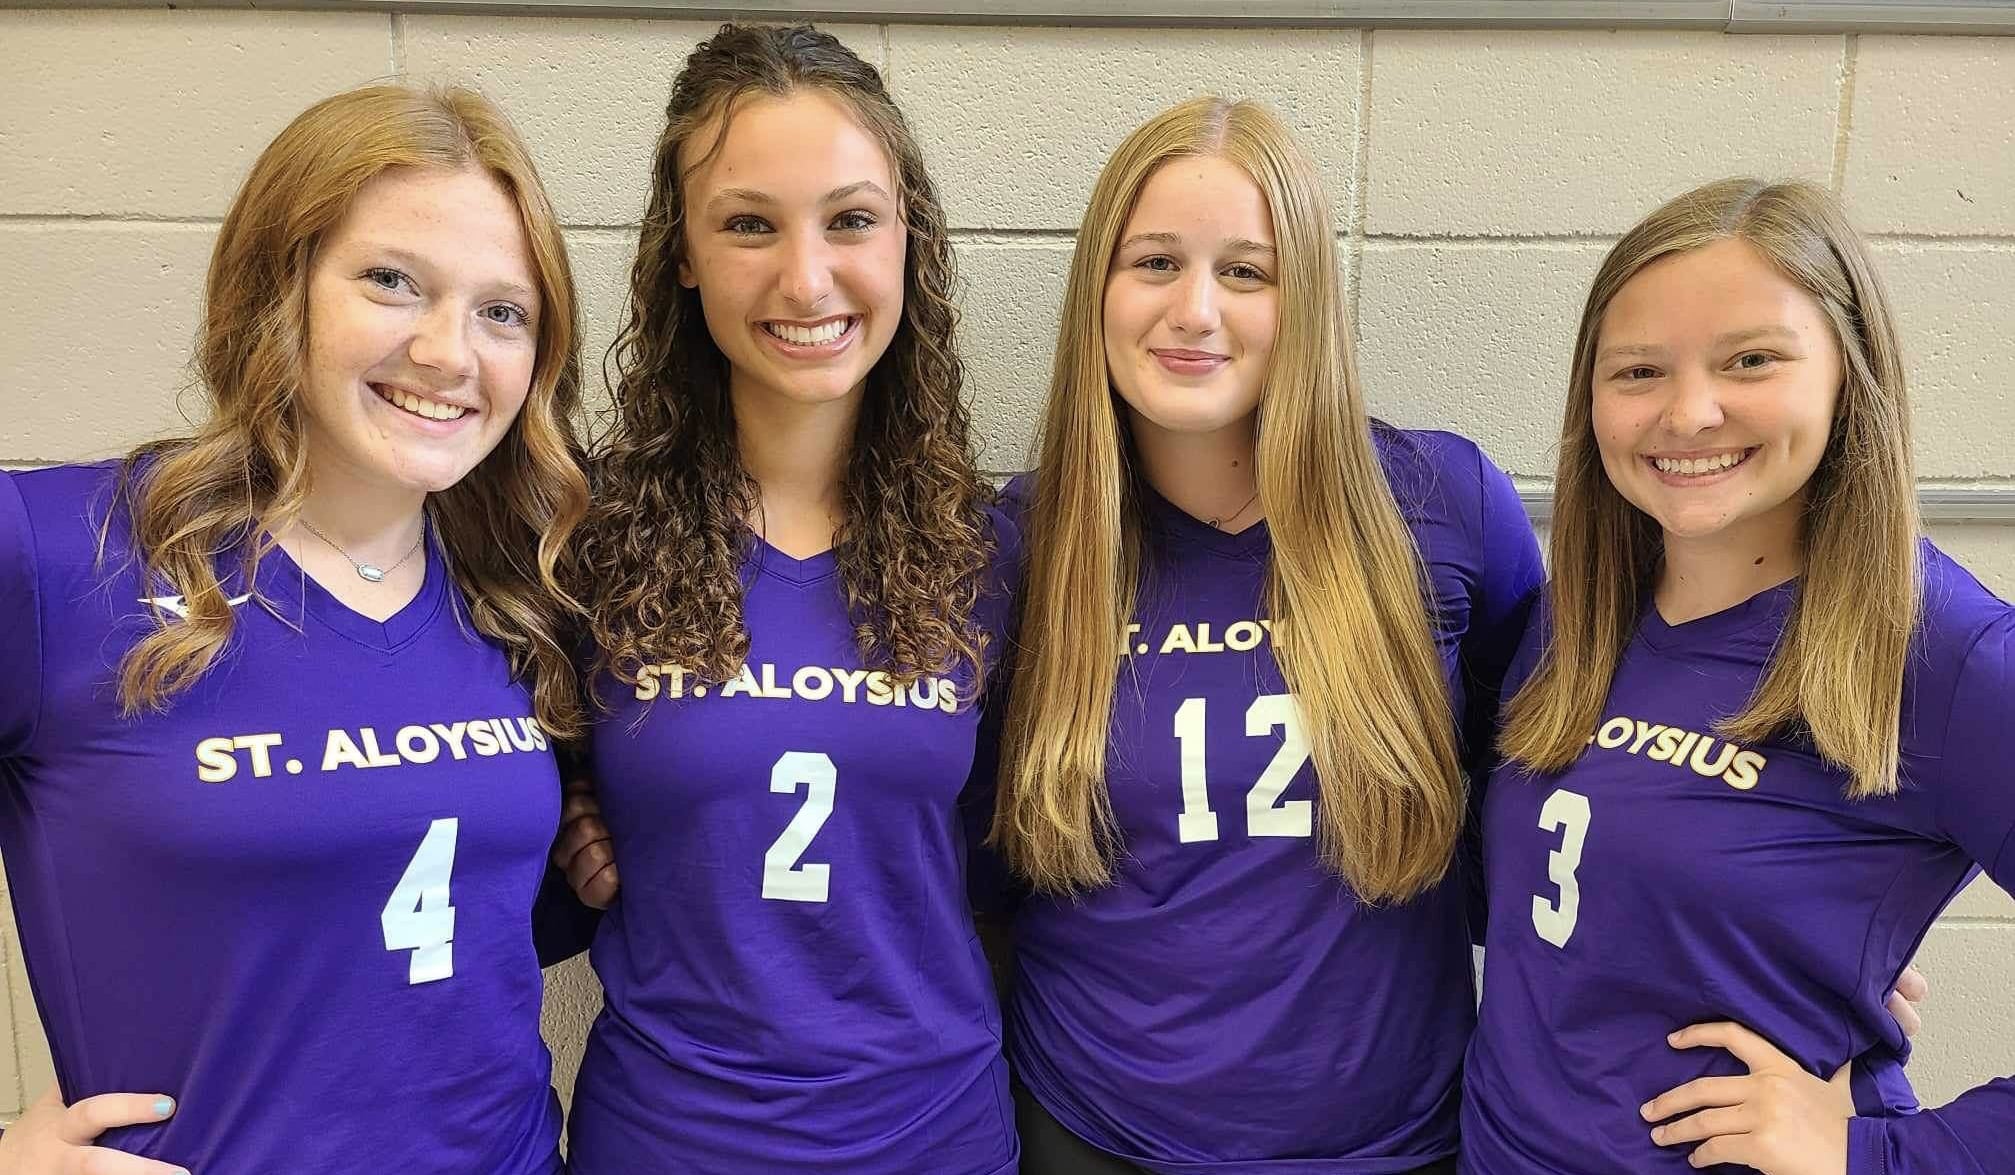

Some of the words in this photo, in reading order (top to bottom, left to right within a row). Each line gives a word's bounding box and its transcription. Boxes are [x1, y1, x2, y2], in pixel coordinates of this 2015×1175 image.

[635, 663, 707, 701] ST.
[720, 663, 958, 713] ALOYSIUS
[1120, 623, 1149, 655] T.
[1160, 619, 1286, 654] ALOY
[196, 733, 304, 783] ST.
[321, 716, 548, 771] ALOYSIUS
[1174, 693, 1314, 843] 12
[1588, 716, 1767, 790] OYSIUS
[761, 750, 838, 903] 2
[1531, 788, 1591, 949] 3
[381, 817, 459, 985] 4
